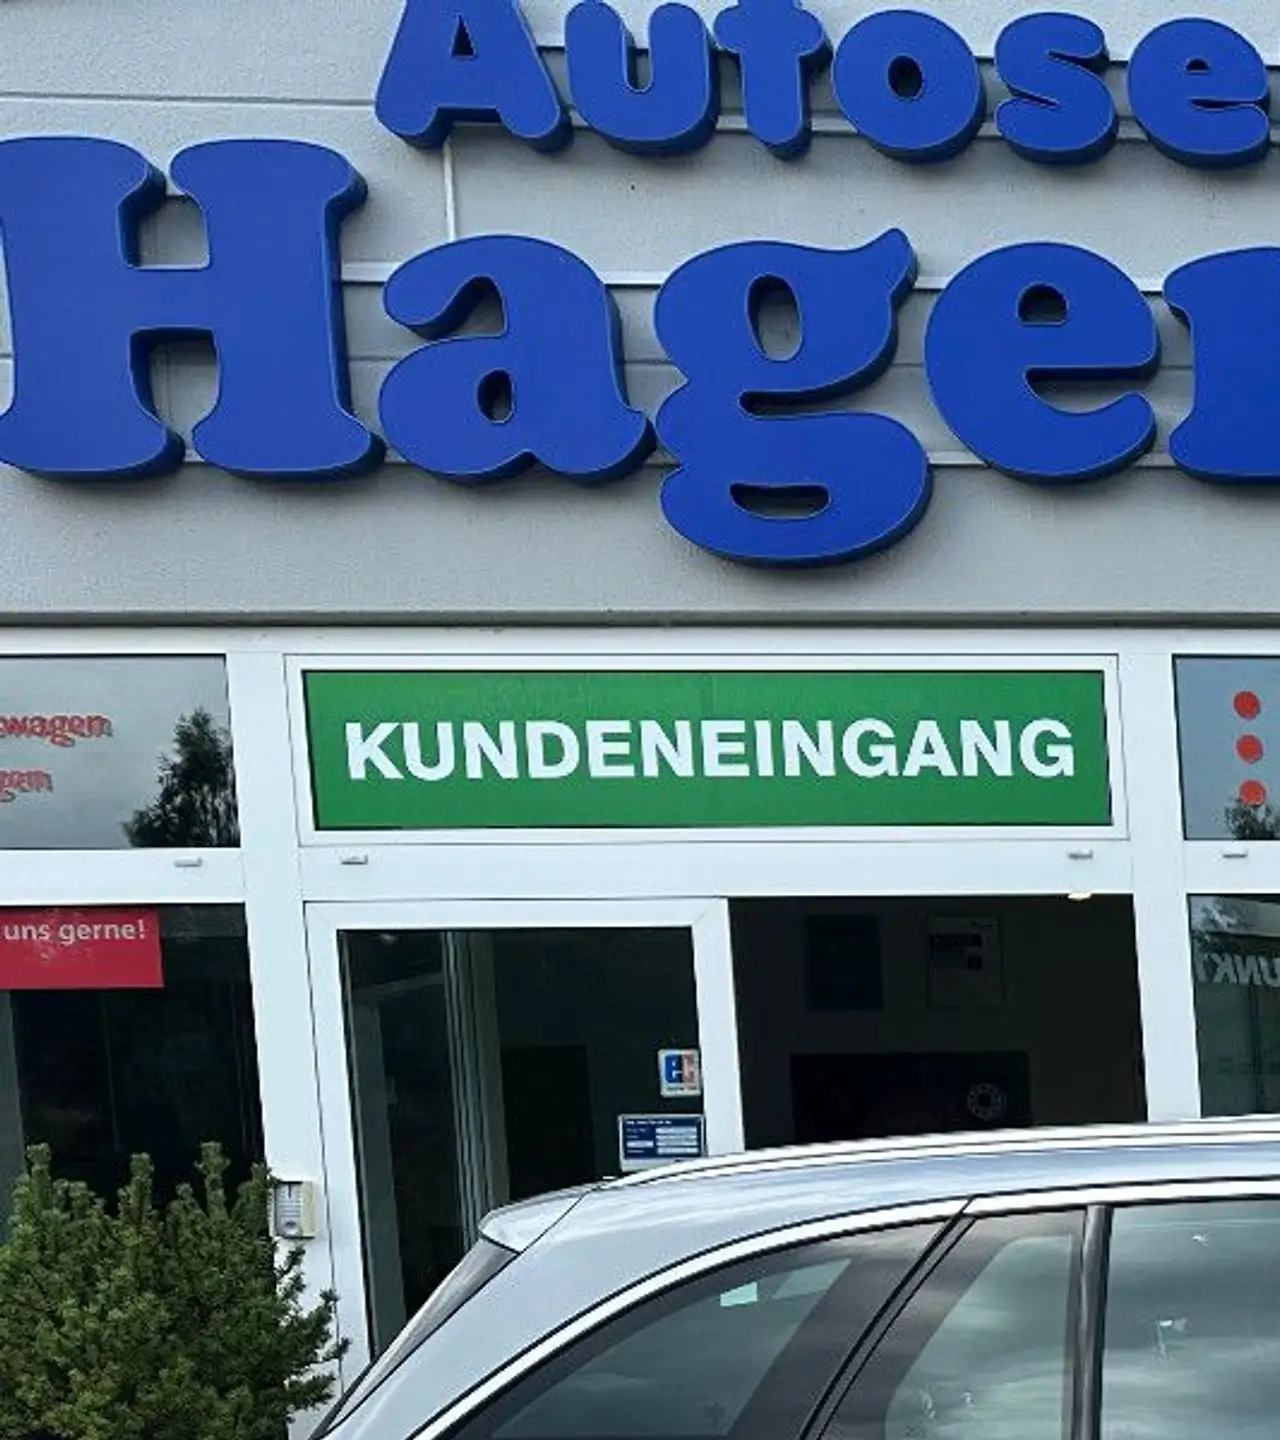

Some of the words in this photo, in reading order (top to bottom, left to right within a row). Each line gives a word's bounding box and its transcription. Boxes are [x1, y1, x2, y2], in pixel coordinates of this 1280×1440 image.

[345, 717, 1076, 782] KUNDENEINGANG
[4, 923, 50, 940] uns
[58, 918, 146, 946] gerne!
